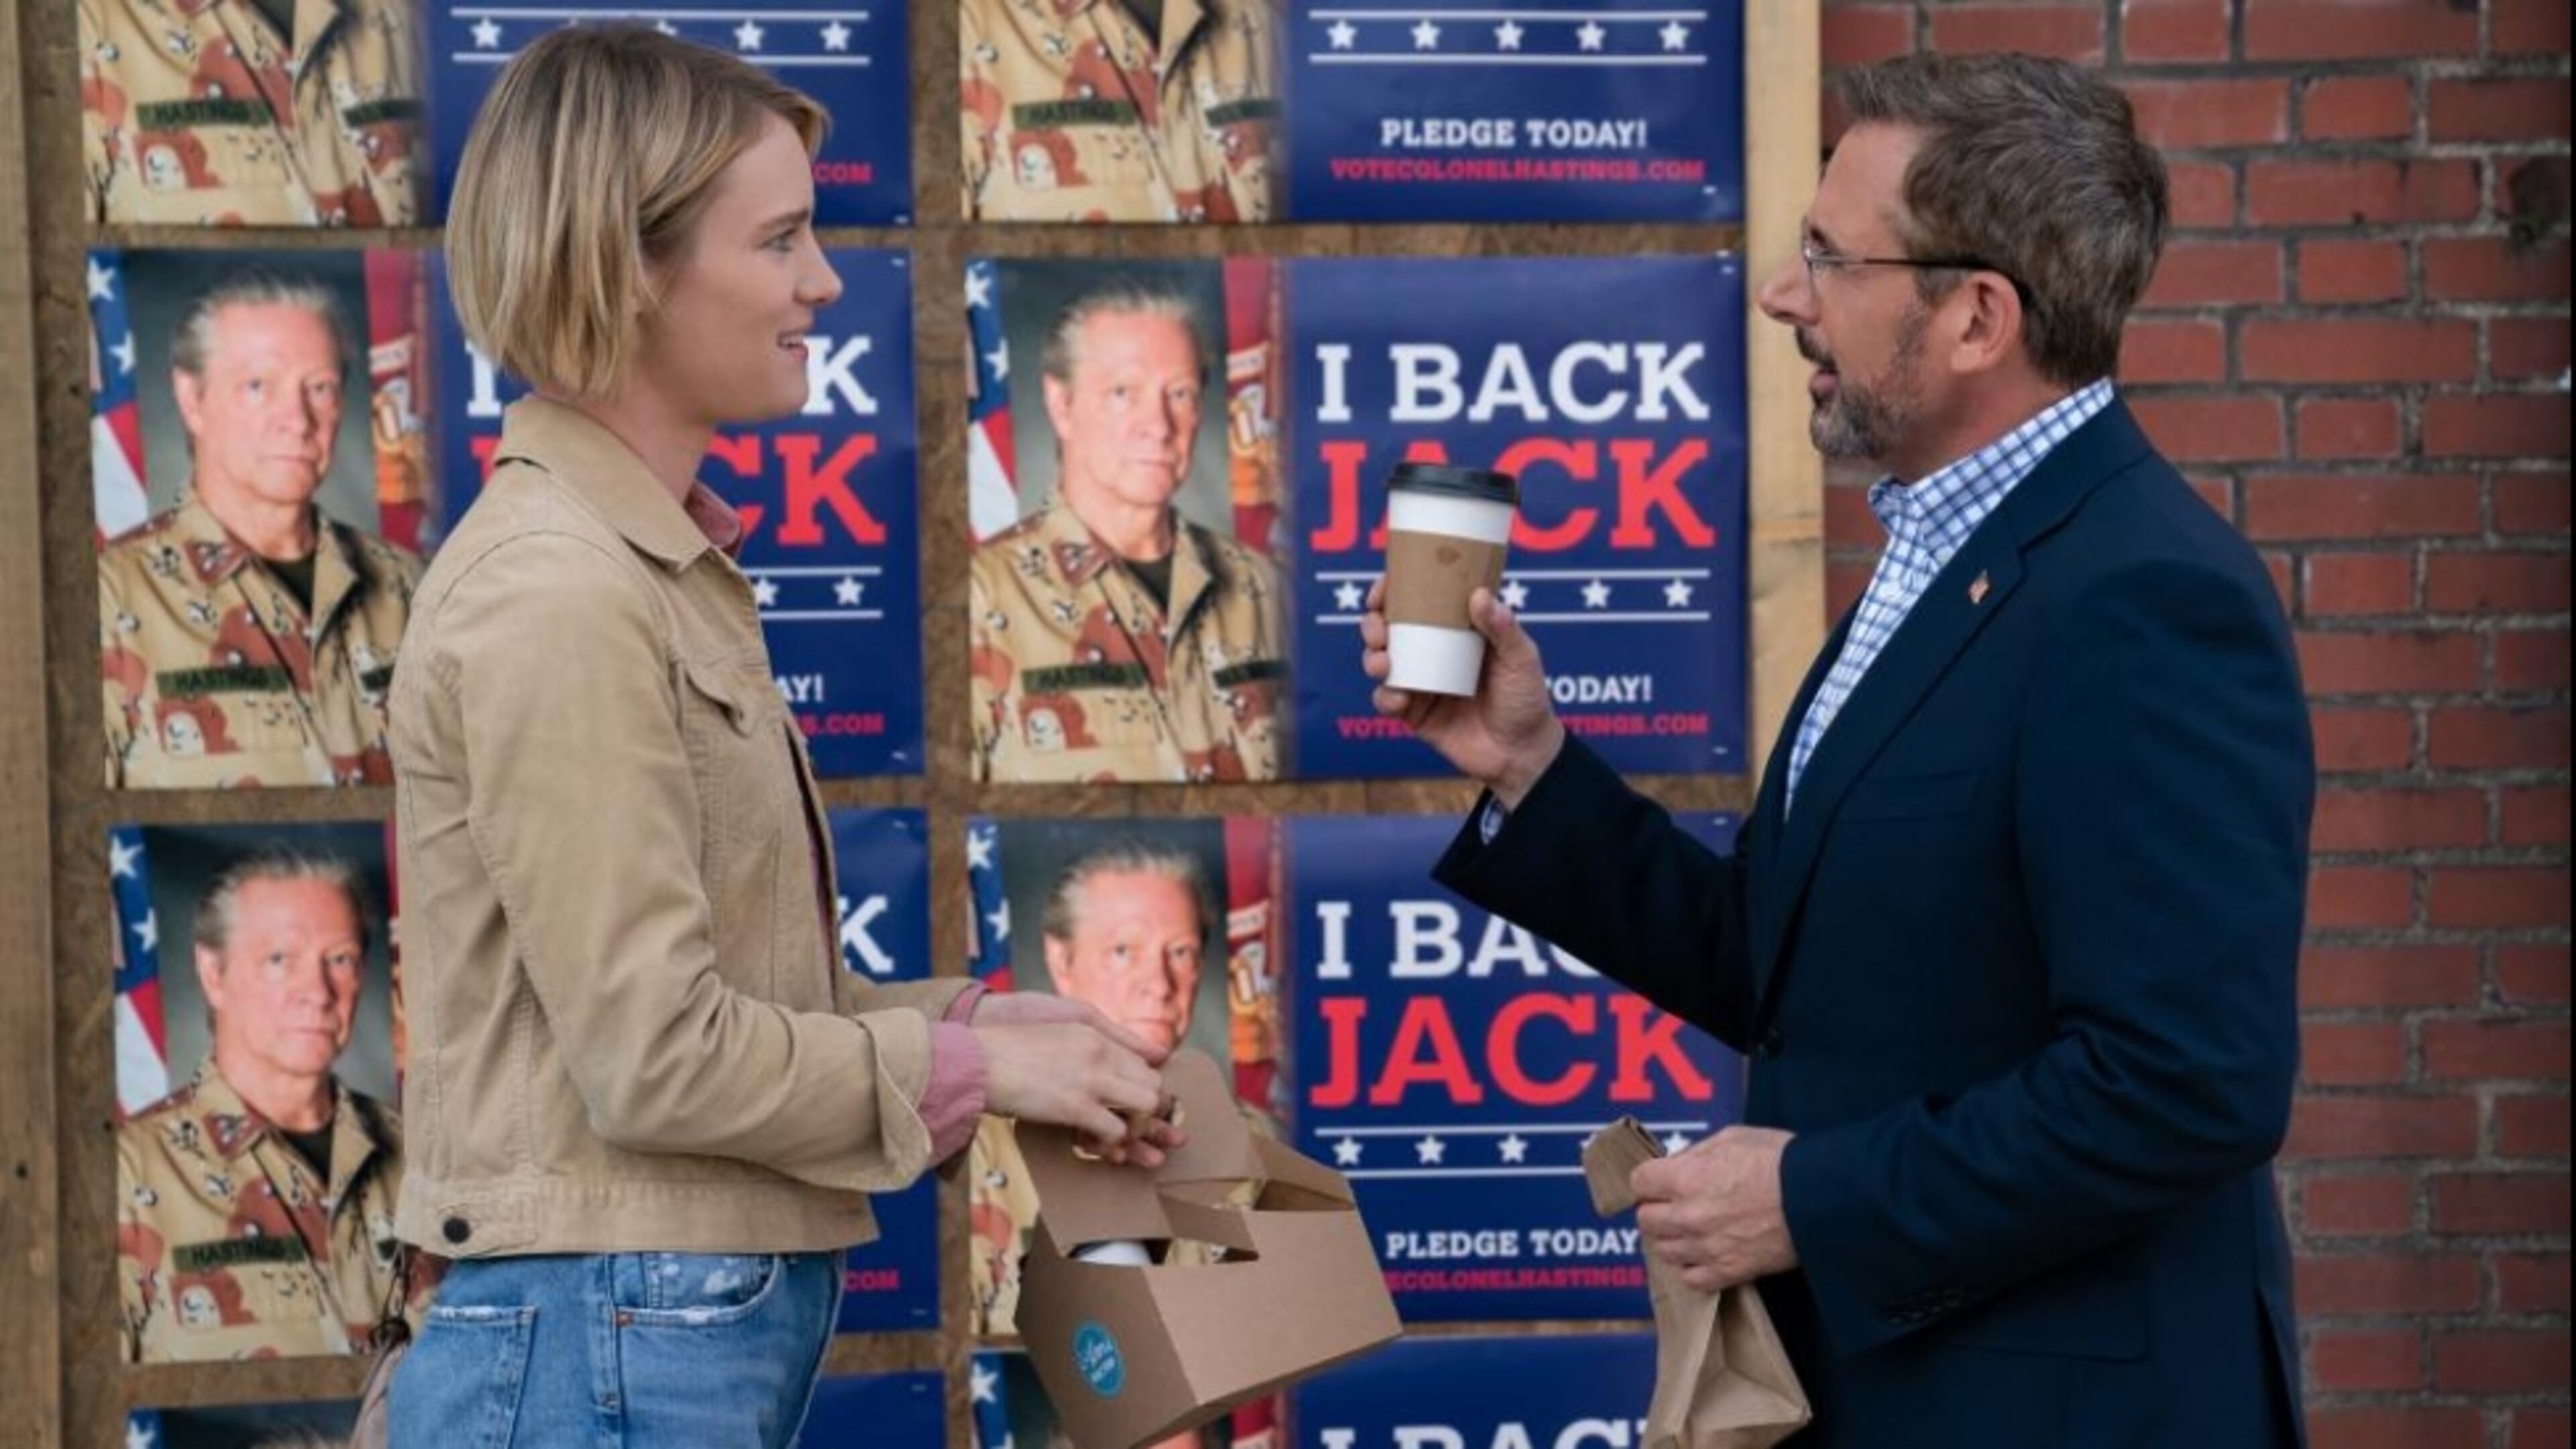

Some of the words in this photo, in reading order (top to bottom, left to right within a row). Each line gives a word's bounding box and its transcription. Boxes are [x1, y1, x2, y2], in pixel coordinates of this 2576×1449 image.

[1381, 118, 1515, 147] PLEDGE
[1526, 119, 1648, 148] TODAY!
[1330, 158, 1706, 181] VOTECOLONELHASTINGS.COM
[1316, 343, 1352, 423] I
[1389, 341, 1711, 423] BACK
[1545, 675, 1652, 704] ODAY!
[1316, 901, 1352, 978] I
[1389, 901, 1602, 977] BA
[1309, 991, 1715, 1109] JACK
[1387, 1230, 1519, 1258] PLEDGE
[1530, 1228, 1640, 1256] TODAY
